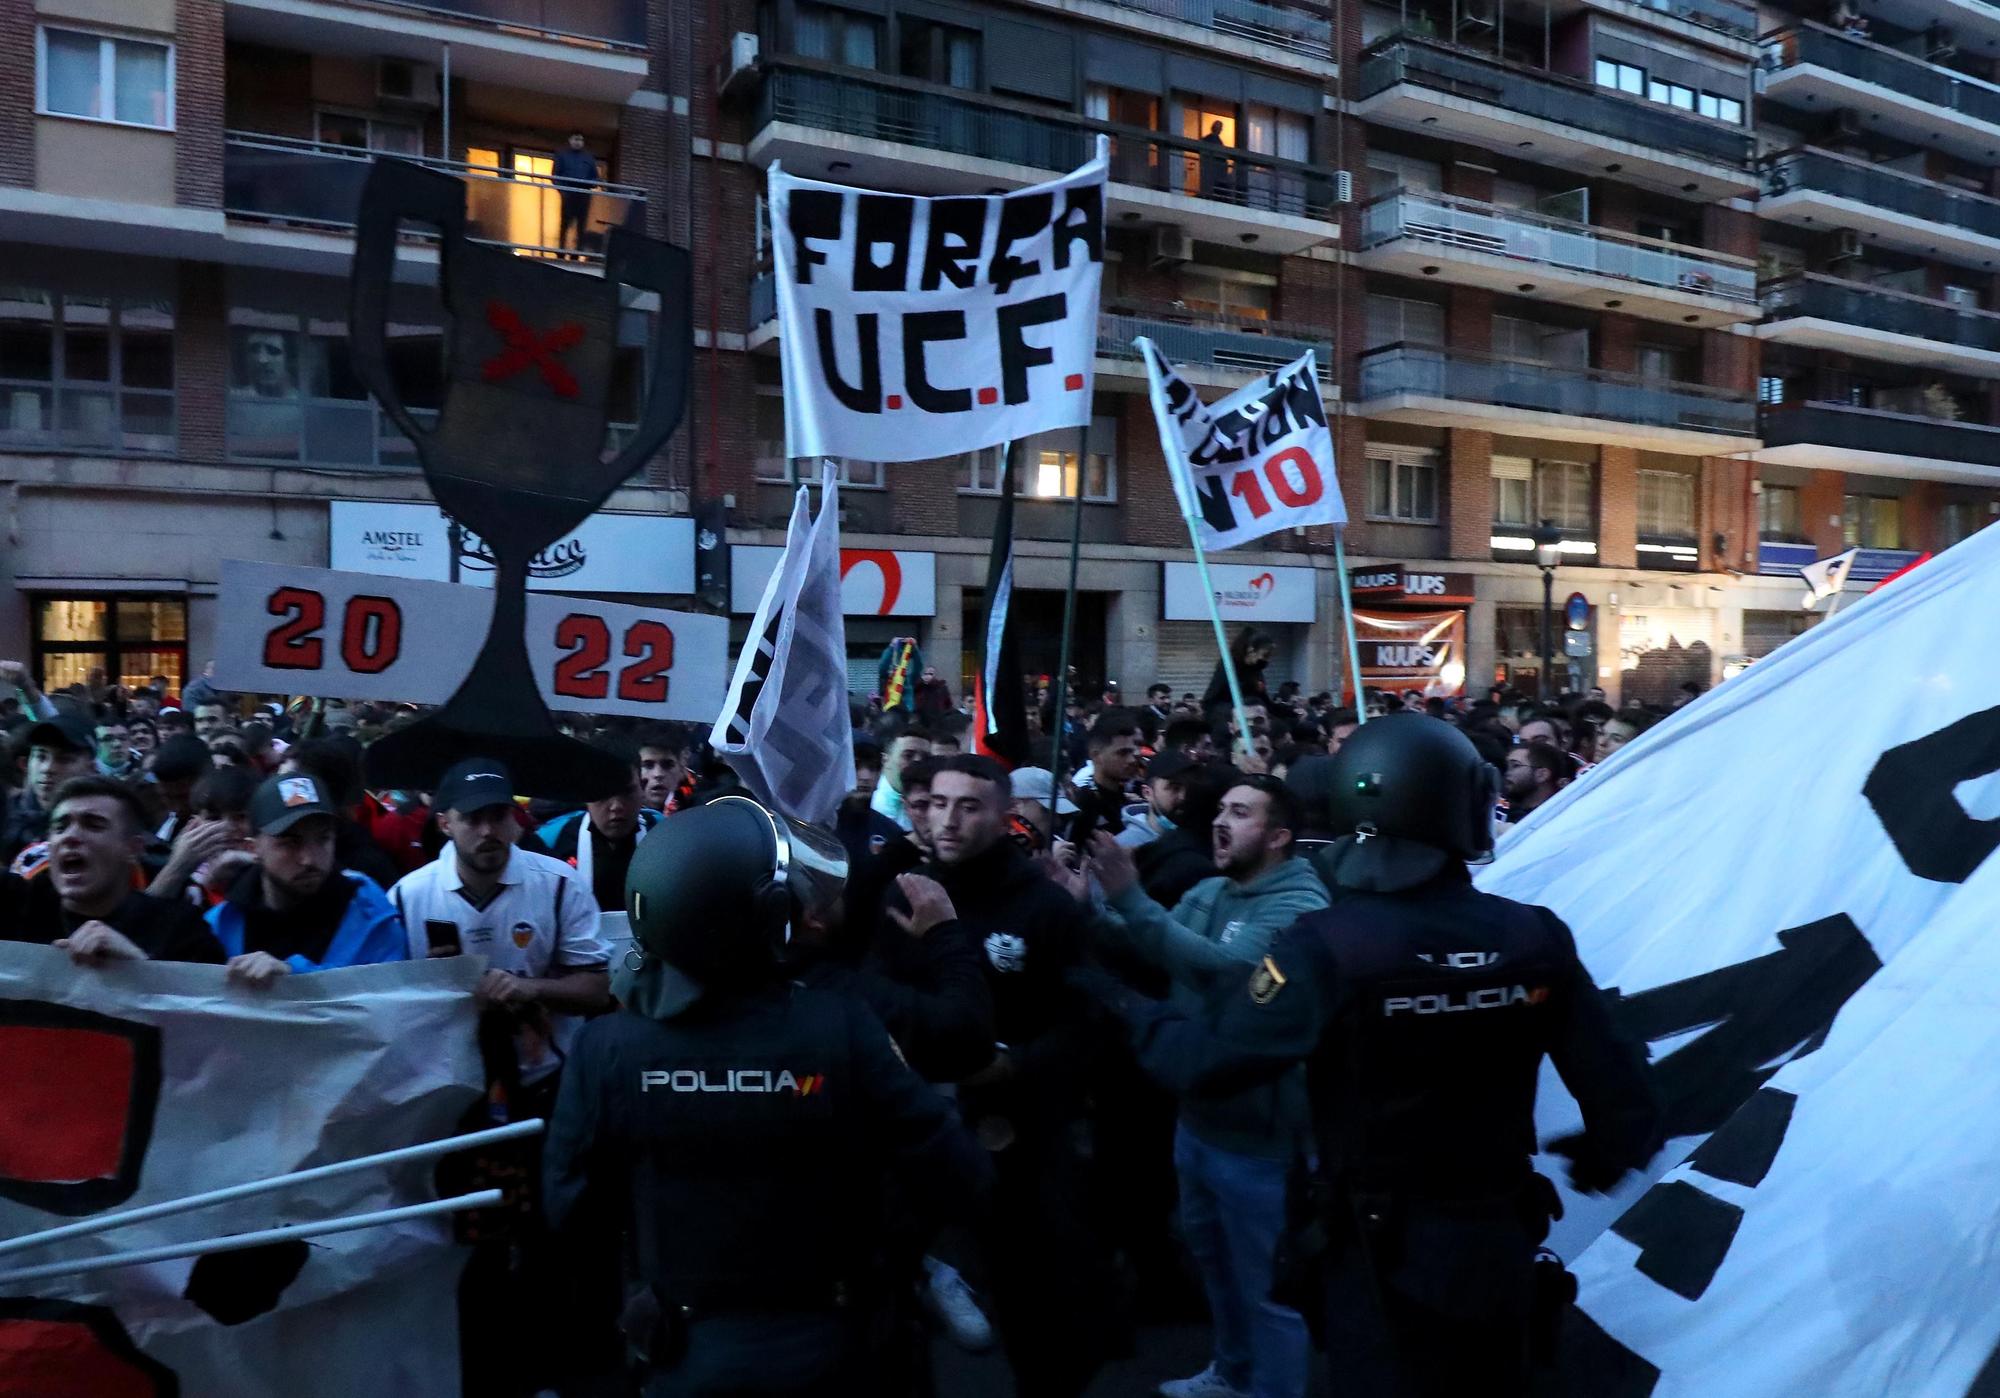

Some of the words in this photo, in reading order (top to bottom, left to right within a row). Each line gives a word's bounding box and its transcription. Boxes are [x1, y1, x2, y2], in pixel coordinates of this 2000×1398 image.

[815, 294, 1085, 414] U.C.F.
[361, 530, 424, 546] AMSTEL
[1403, 574, 1446, 595] UUPS
[264, 586, 401, 674] 20
[554, 612, 674, 703] 22
[1383, 984, 1531, 1017] POLICIA
[641, 1068, 798, 1094] POLICIA
